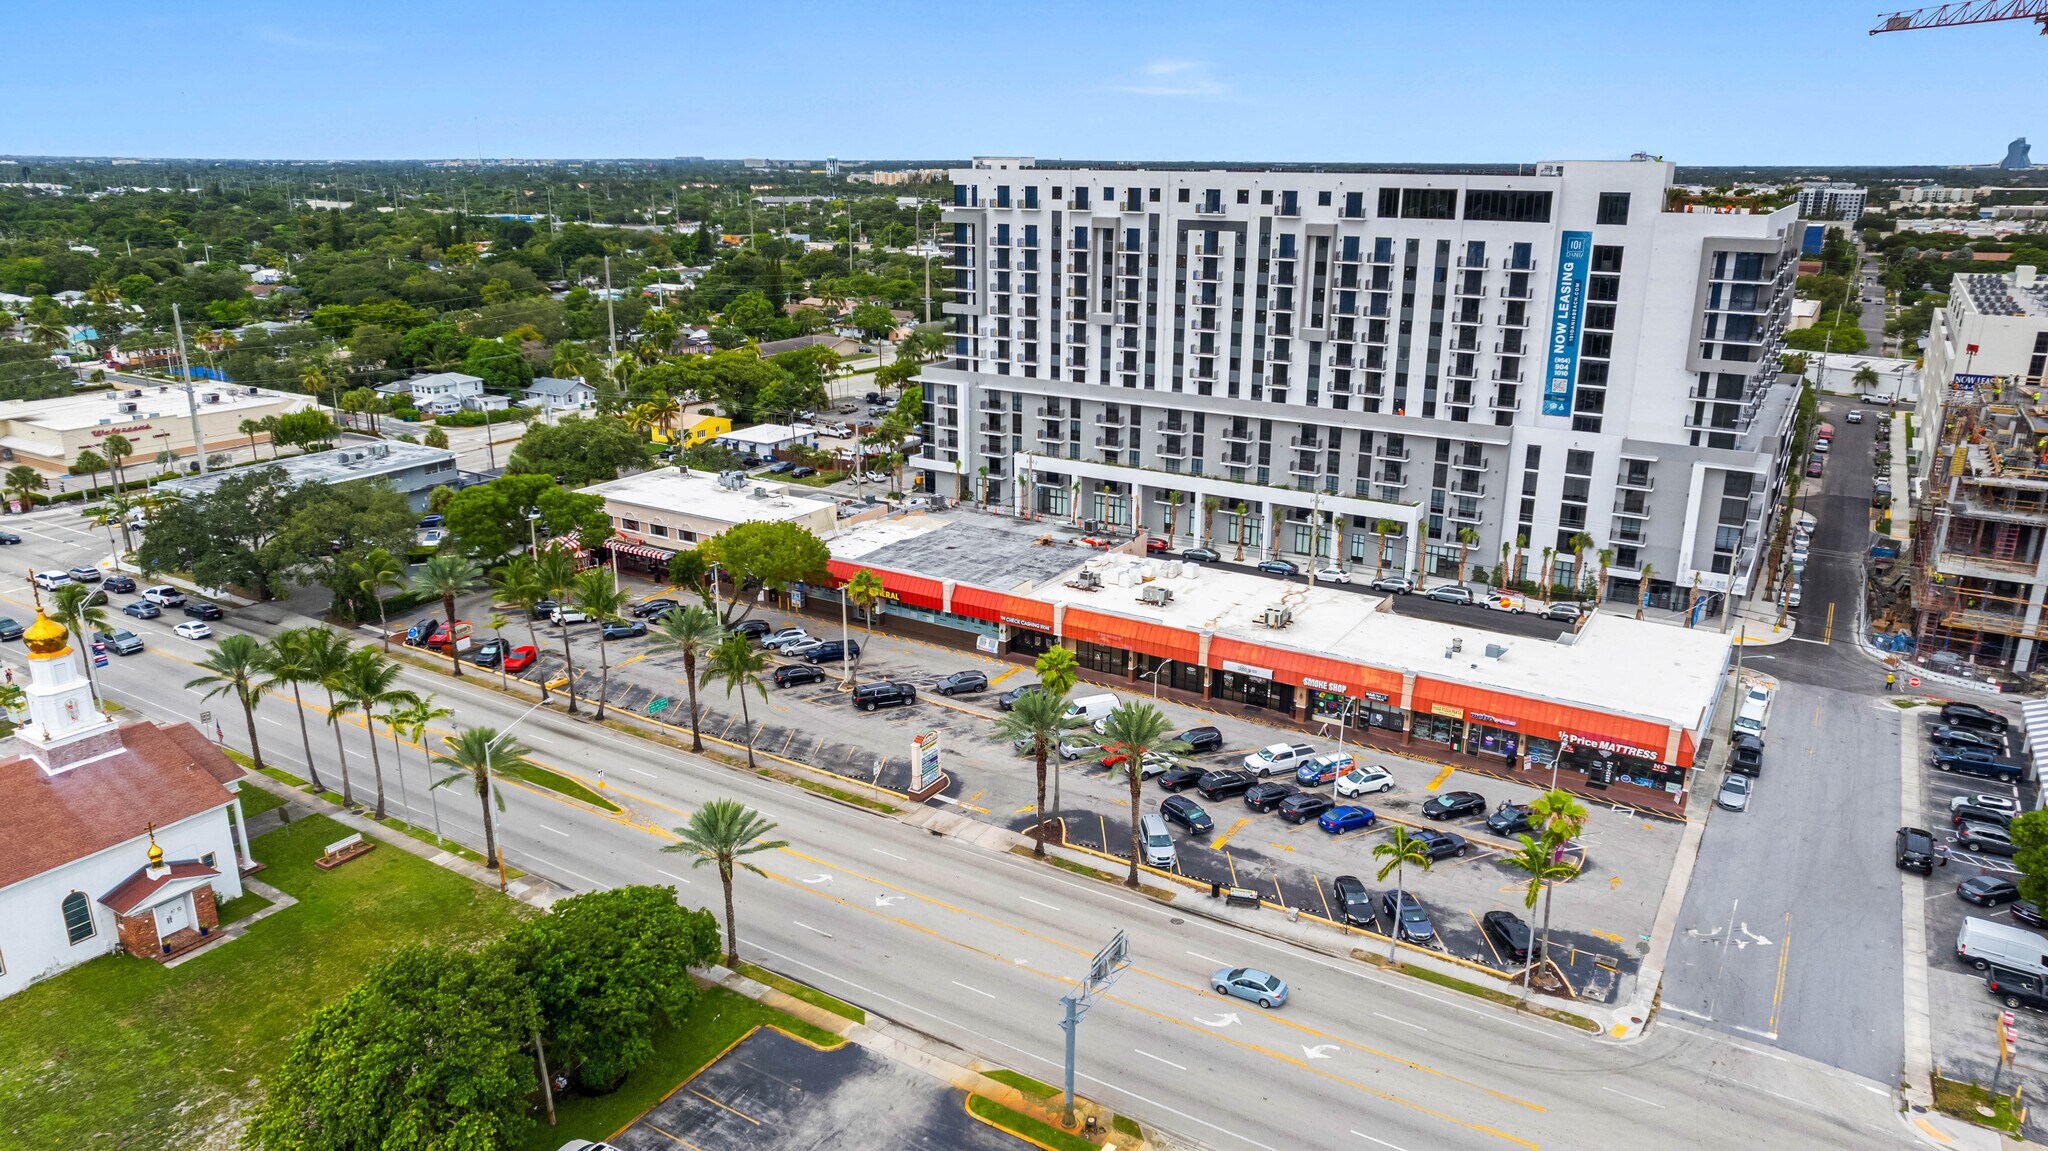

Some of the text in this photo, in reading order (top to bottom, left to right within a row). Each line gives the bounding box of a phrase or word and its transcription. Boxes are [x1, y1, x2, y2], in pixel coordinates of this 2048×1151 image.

[1570, 240, 1582, 250] 101
[1554, 262, 1574, 353] NOW LEASING
[1955, 375, 1976, 383] NOW
[91, 424, 152, 437] Walgreens
[1005, 617, 1020, 625] CHECK
[1021, 620, 1041, 629] CASHING
[1303, 677, 1347, 694] SMOKE SHOP
[1470, 711, 1494, 722] metro
[1569, 734, 1598, 748] Price
[1599, 740, 1658, 760] MATTRESS
